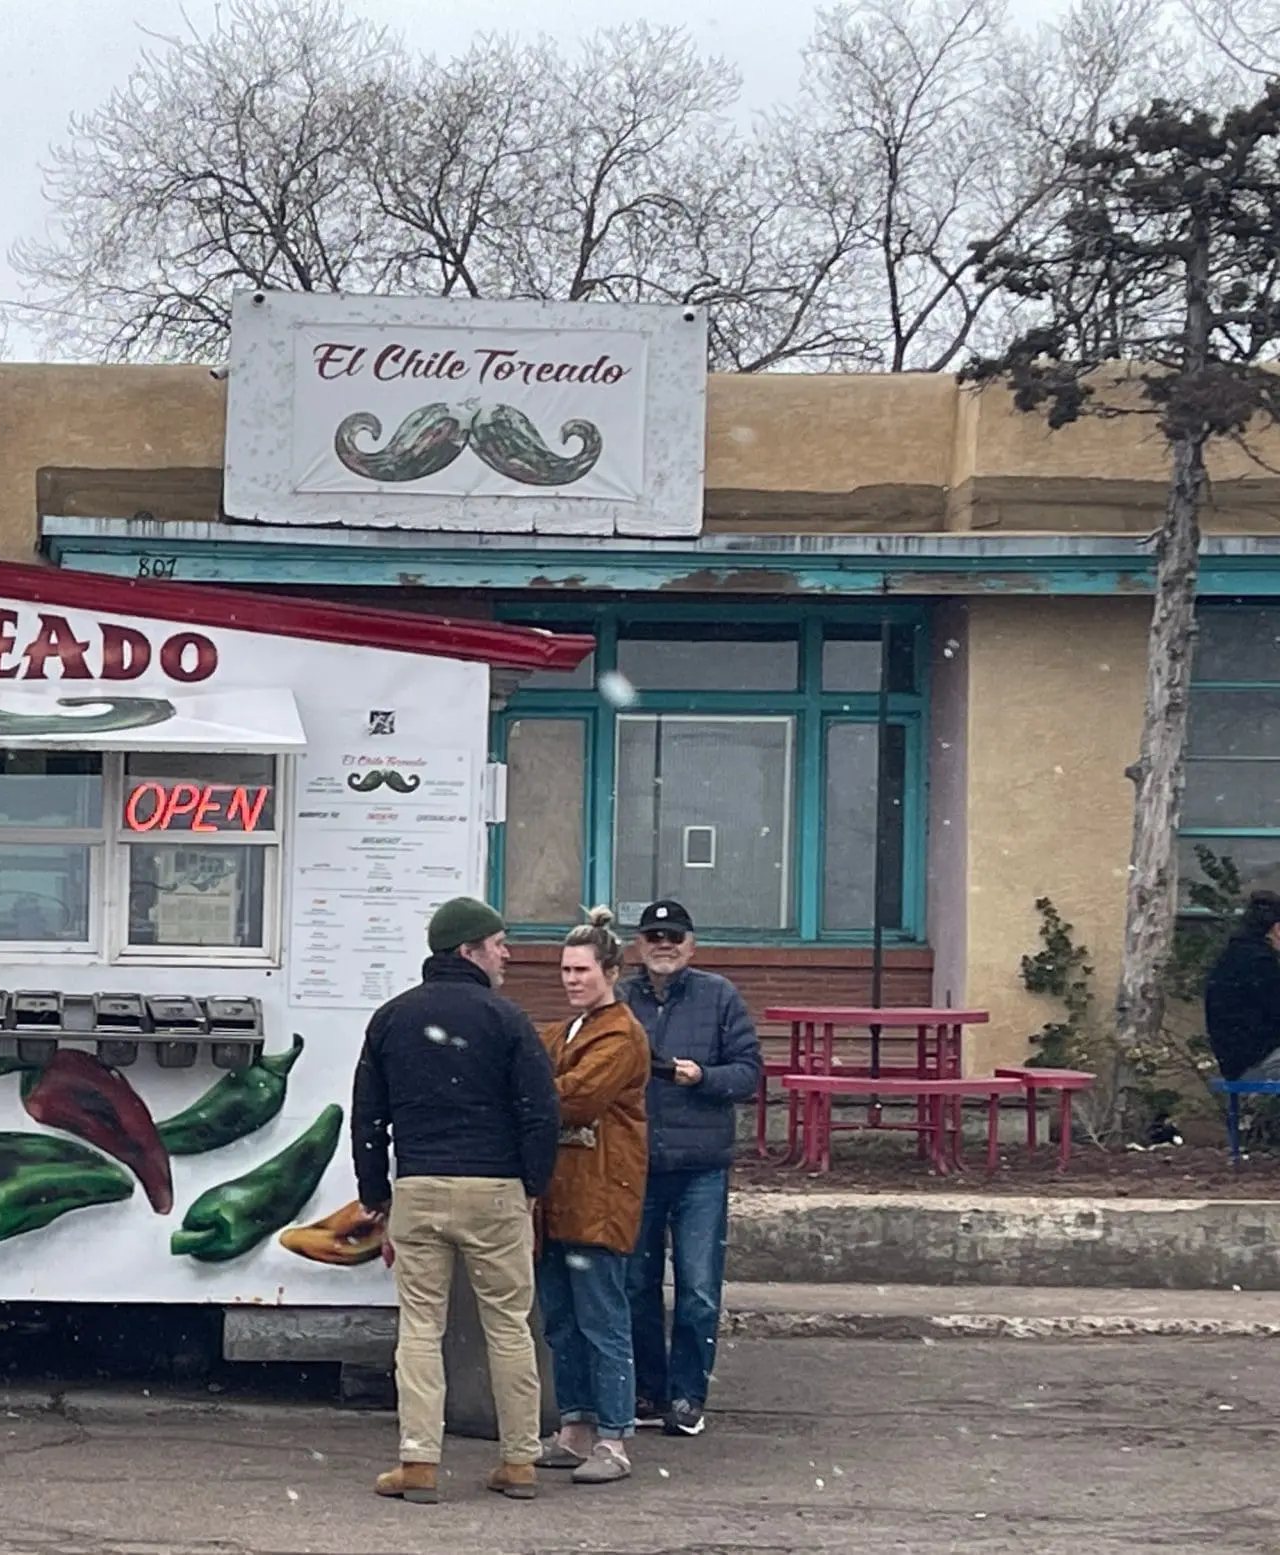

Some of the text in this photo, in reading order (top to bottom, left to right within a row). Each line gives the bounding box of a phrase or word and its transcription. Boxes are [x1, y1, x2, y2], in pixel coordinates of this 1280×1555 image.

[313, 343, 632, 385] El Chile Toreado
[126, 782, 268, 832] OPEN
